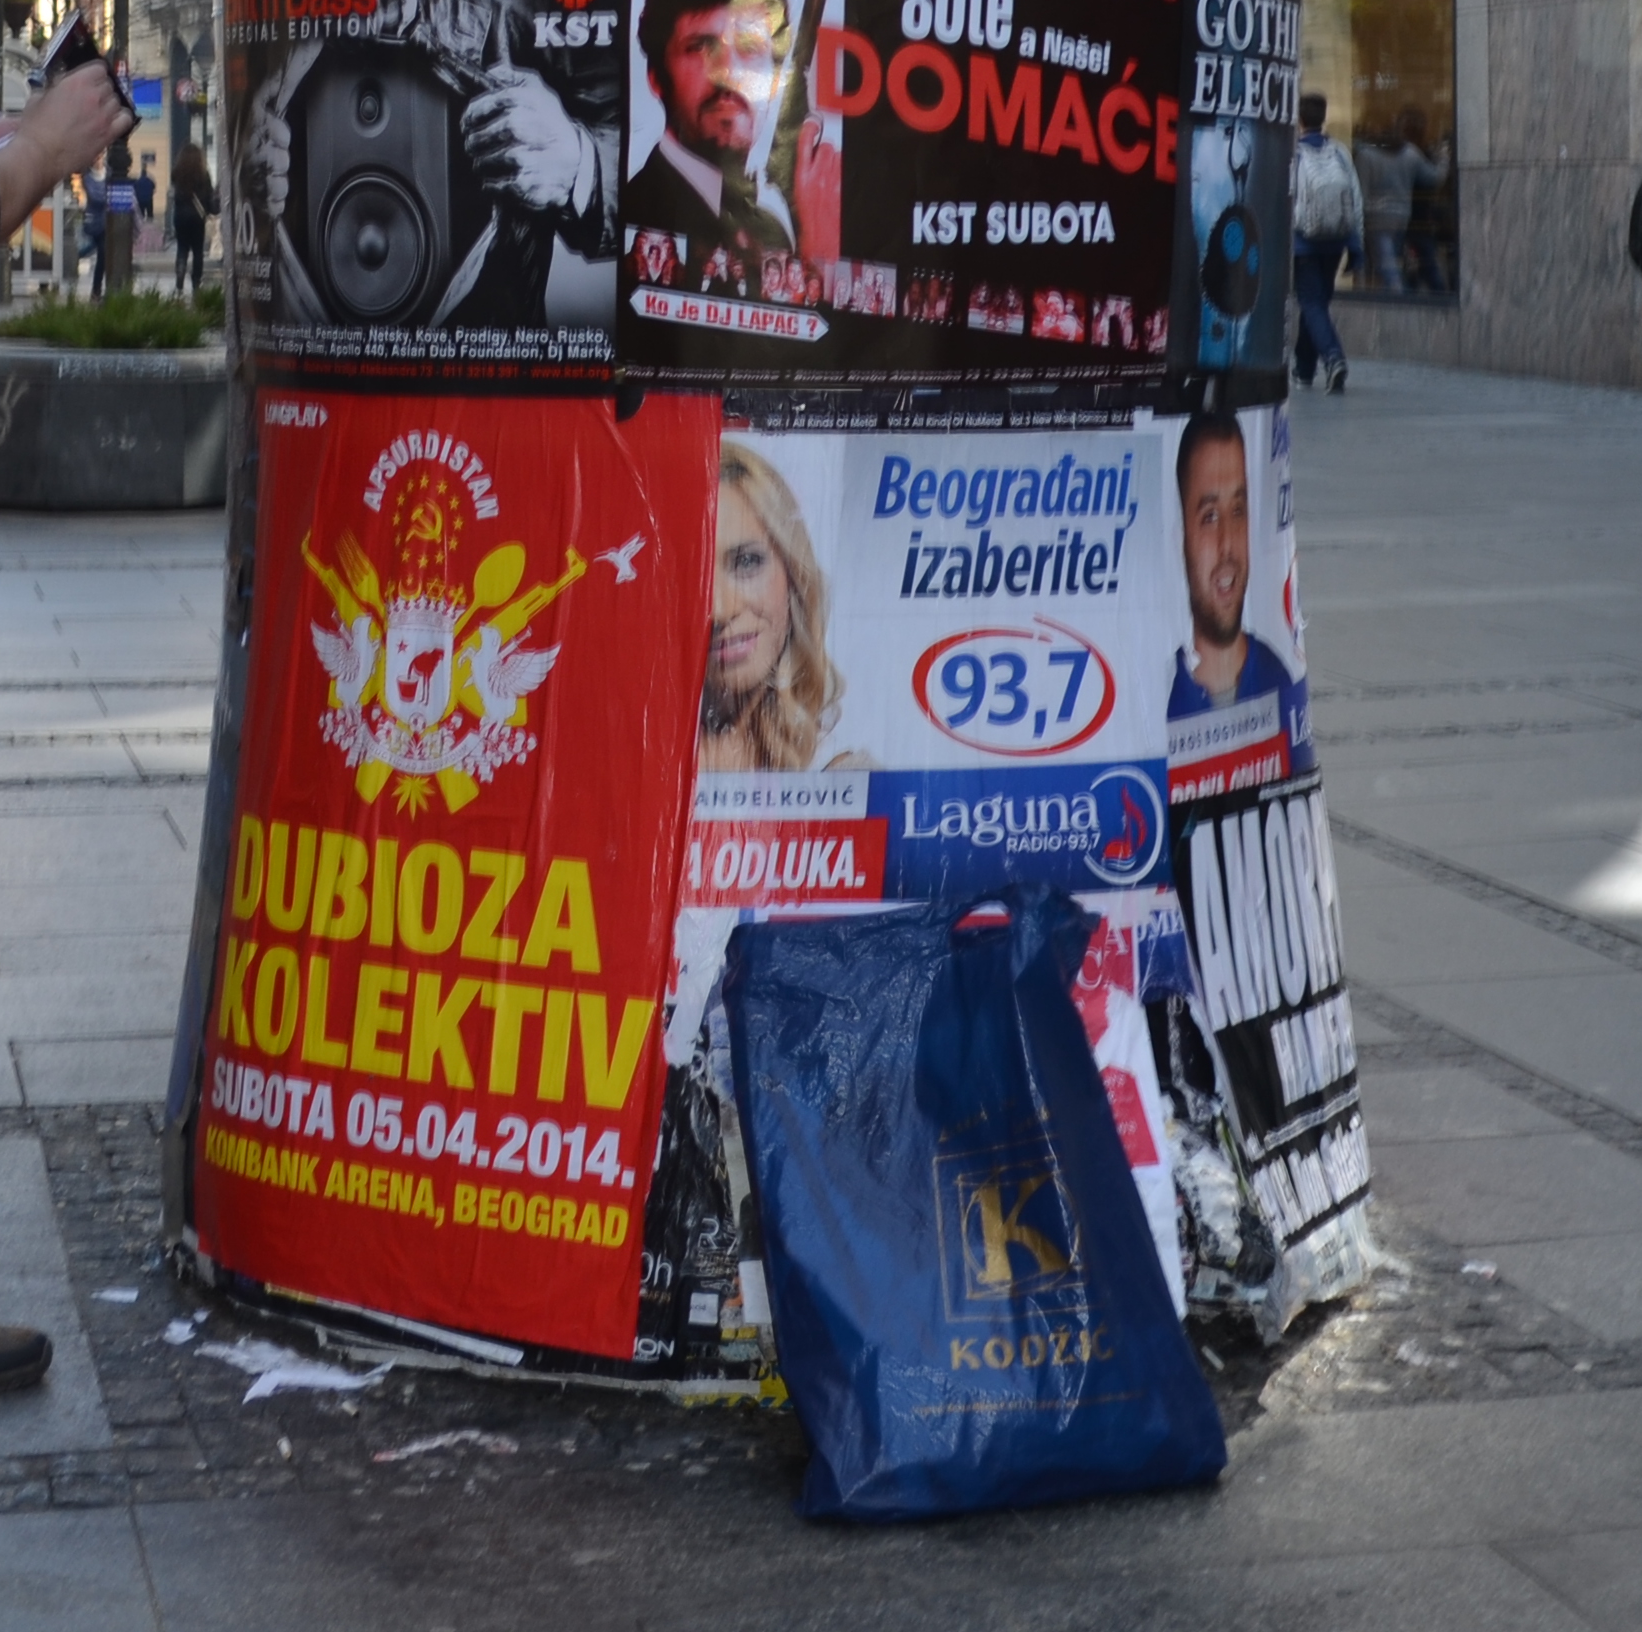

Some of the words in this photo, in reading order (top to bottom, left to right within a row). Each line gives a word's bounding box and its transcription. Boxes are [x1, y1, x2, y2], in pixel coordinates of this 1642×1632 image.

[225, 19, 279, 46] SPECIAL
[287, 13, 379, 40] EDITION
[533, 11, 618, 48] KST
[1042, 24, 1112, 76] Naše!
[911, 200, 977, 246] KST
[985, 200, 1116, 246] SUBOTA
[368, 328, 412, 346] Netsky,
[454, 330, 510, 347] Prodigy,
[514, 330, 554, 345] Nero,
[557, 330, 610, 346] Rusko,
[644, 293, 669, 317] Ko
[675, 299, 700, 321] Je
[706, 303, 732, 327] DJ
[390, 343, 427, 358] Asian
[429, 344, 457, 359] Dub
[459, 344, 545, 361] Foundation,
[363, 429, 500, 522] APSURDISTAN
[872, 449, 1139, 528] Beograđani,
[899, 527, 1125, 600] izaberite!
[939, 647, 1094, 741] 93,7
[694, 783, 855, 810] ANĐELKOVIĆ
[902, 791, 1101, 847] Laguna
[714, 836, 867, 891] ODLUKA.
[231, 814, 602, 975] DUBIOZA
[217, 935, 656, 1112] KOLEKTIV
[210, 1057, 335, 1143] SUBOTA
[345, 1090, 637, 1190] 05.04.2014.
[204, 1122, 318, 1196] KOMBANK
[324, 1156, 445, 1232] ARENA,
[452, 1182, 629, 1250] BEOGRAD
[948, 1322, 1116, 1371] KODŽIĆ
